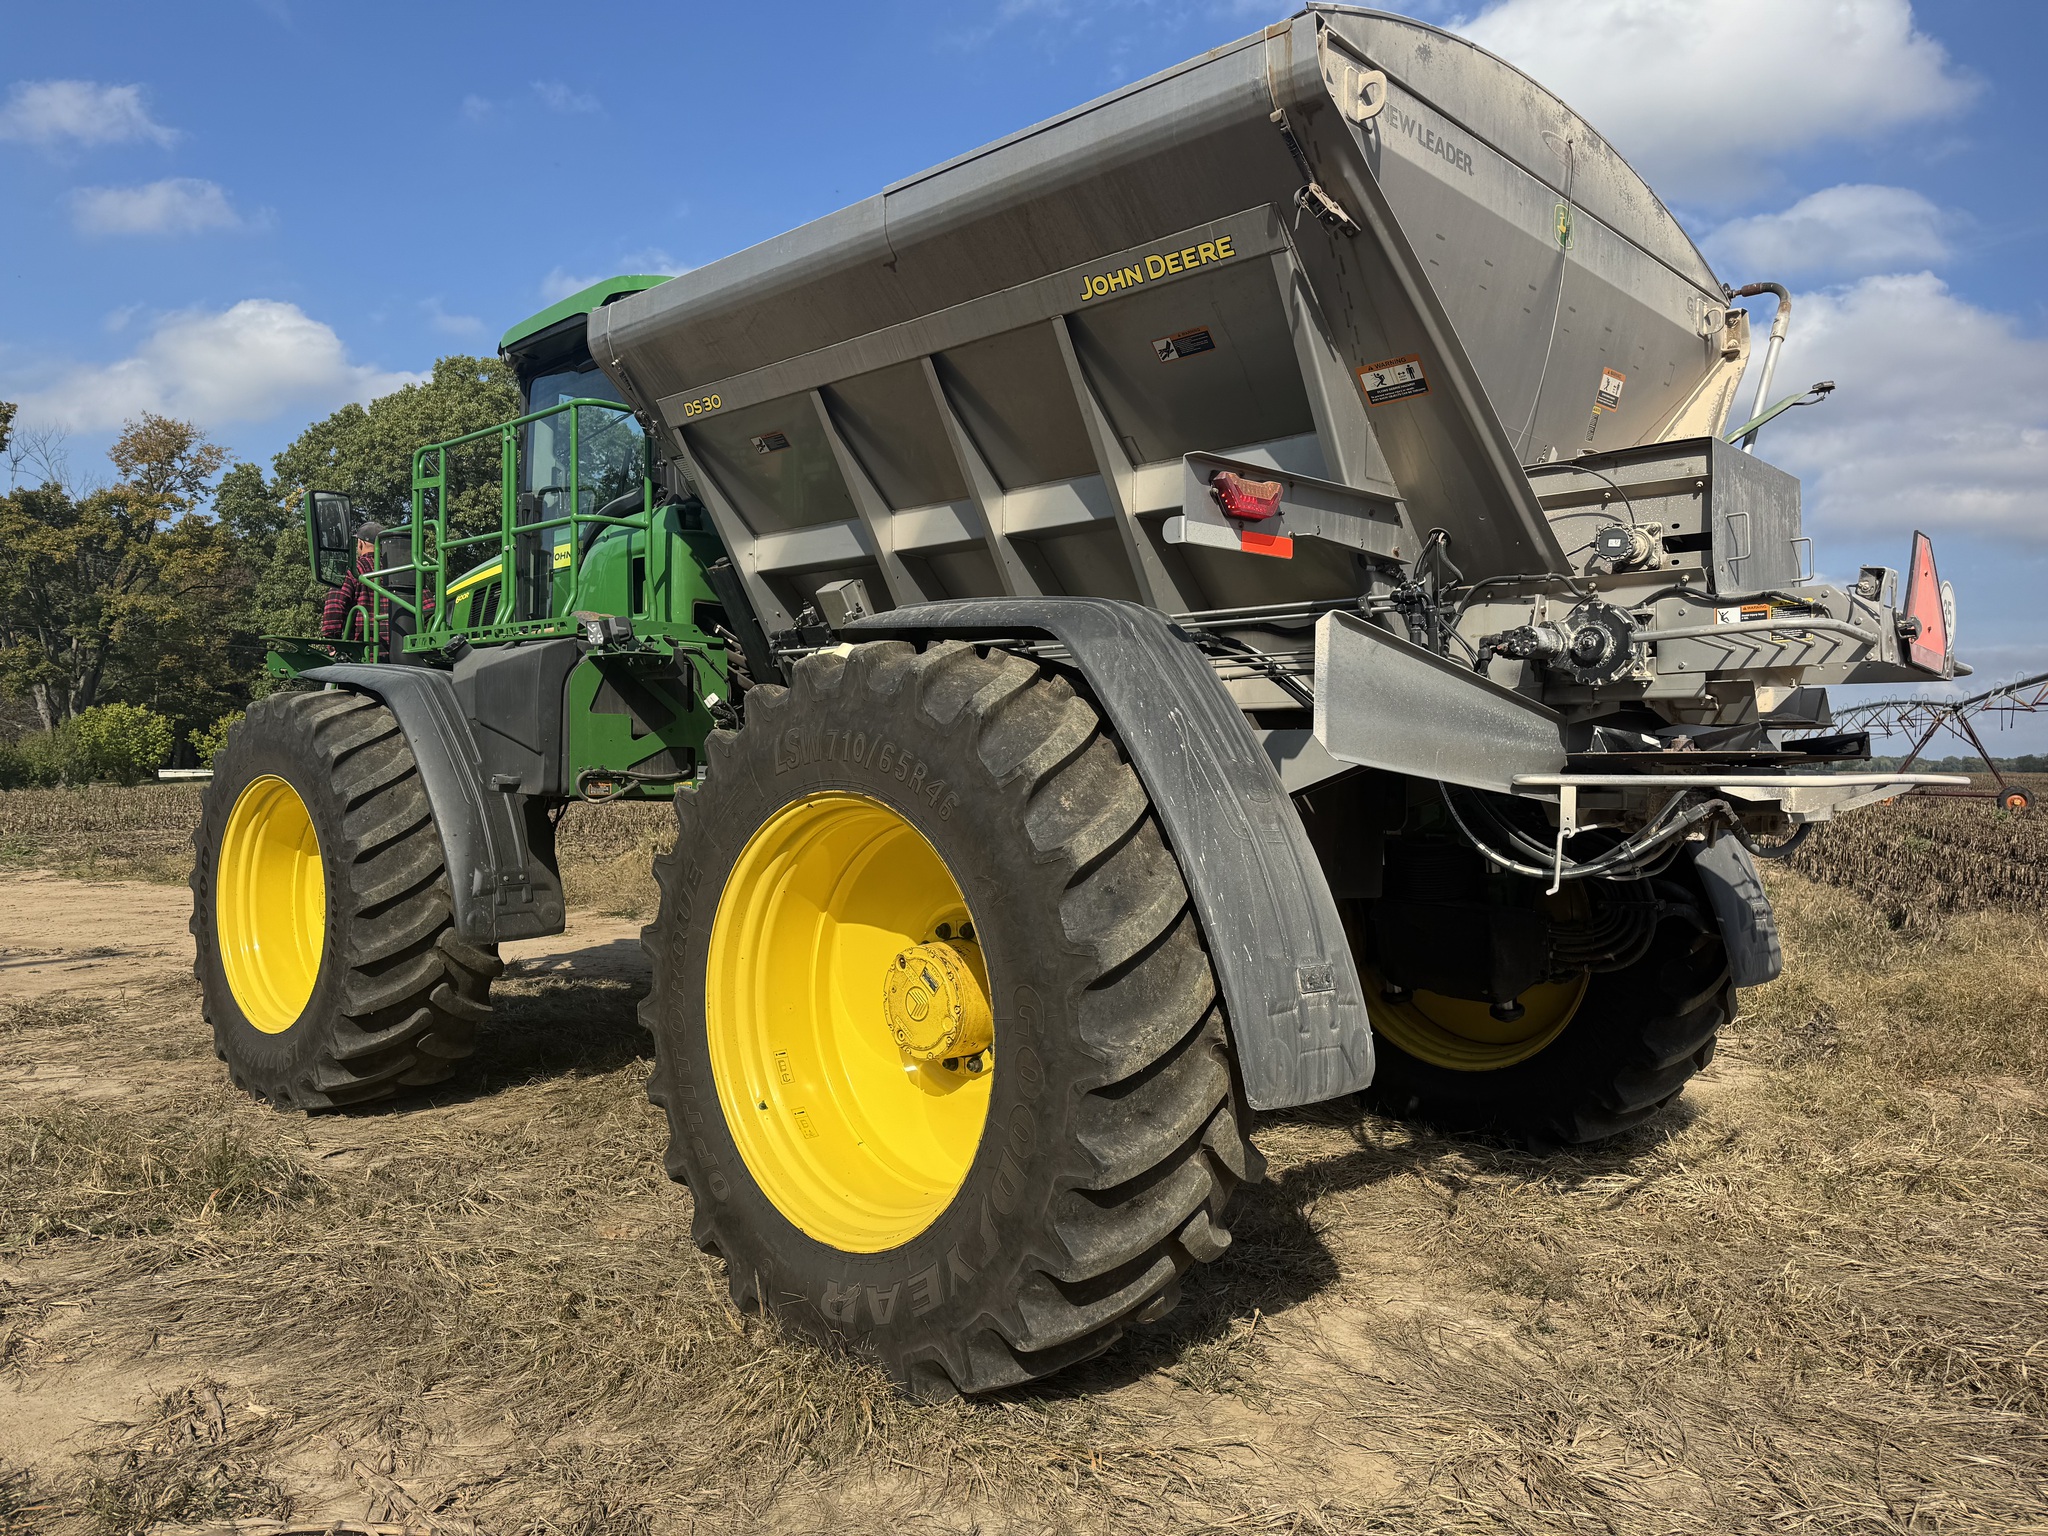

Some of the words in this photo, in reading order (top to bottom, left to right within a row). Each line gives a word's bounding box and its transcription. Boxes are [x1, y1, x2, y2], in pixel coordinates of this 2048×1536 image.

[1080, 263, 1145, 301] JOHN
[1144, 235, 1236, 281] DEERE
[1374, 356, 1407, 369] WARNING
[683, 399, 703, 417] DS
[702, 393, 722, 412] 30
[554, 551, 571, 561] OHN
[668, 857, 731, 1202] OPTITORQUE
